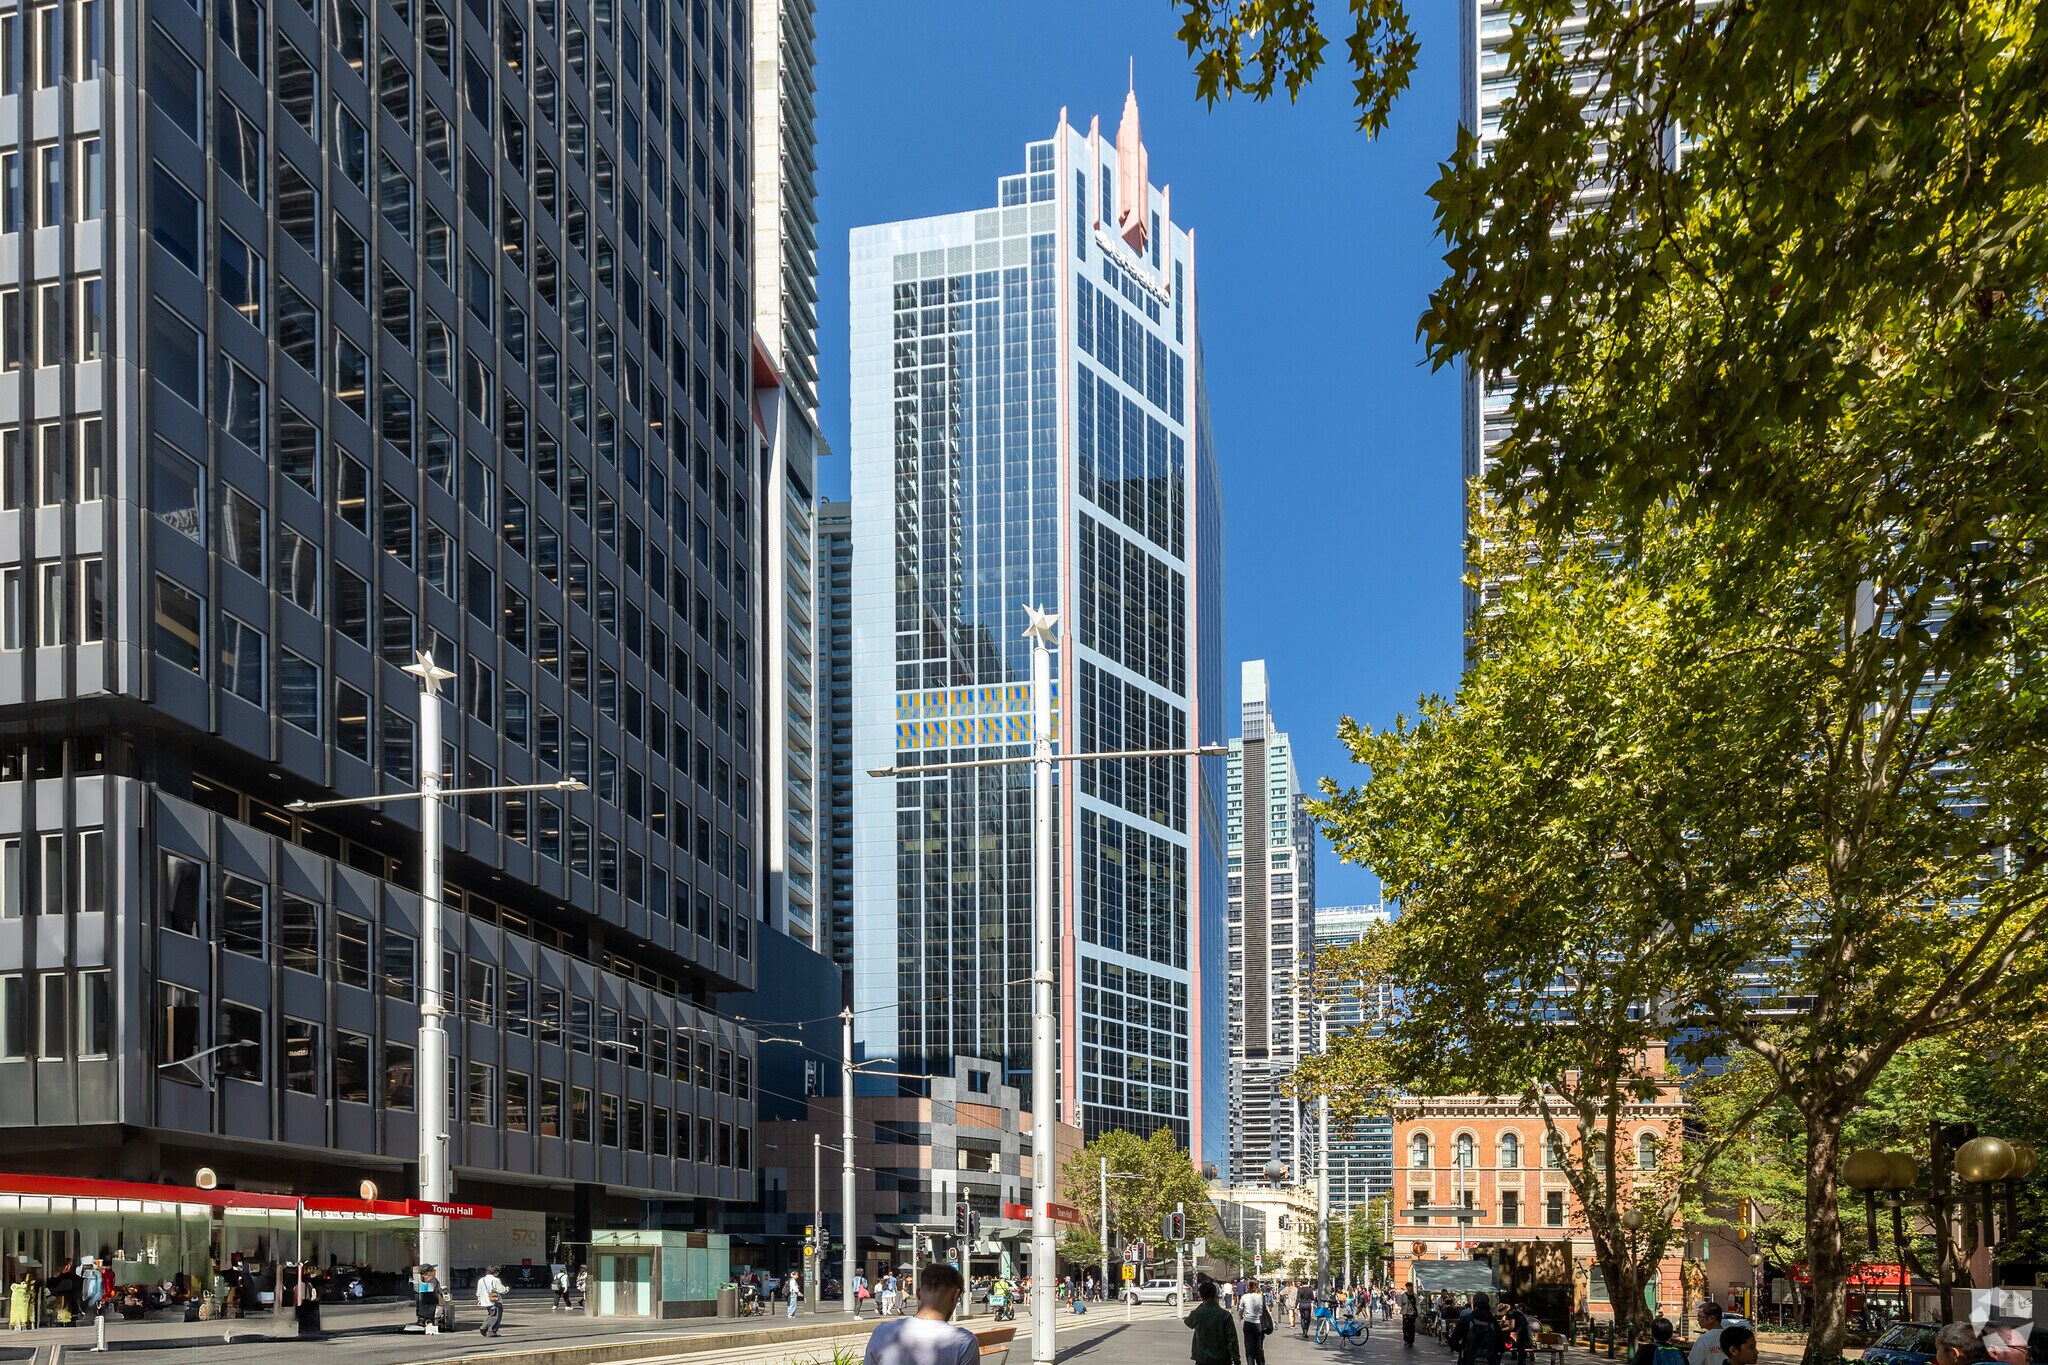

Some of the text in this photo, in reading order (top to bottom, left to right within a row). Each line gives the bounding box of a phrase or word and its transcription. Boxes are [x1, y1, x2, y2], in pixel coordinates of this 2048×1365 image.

[431, 1204, 473, 1216] Town Hall
[1057, 1207, 1066, 1217] Town
[511, 1228, 539, 1242] 570
[1124, 1268, 1133, 1278] 15
